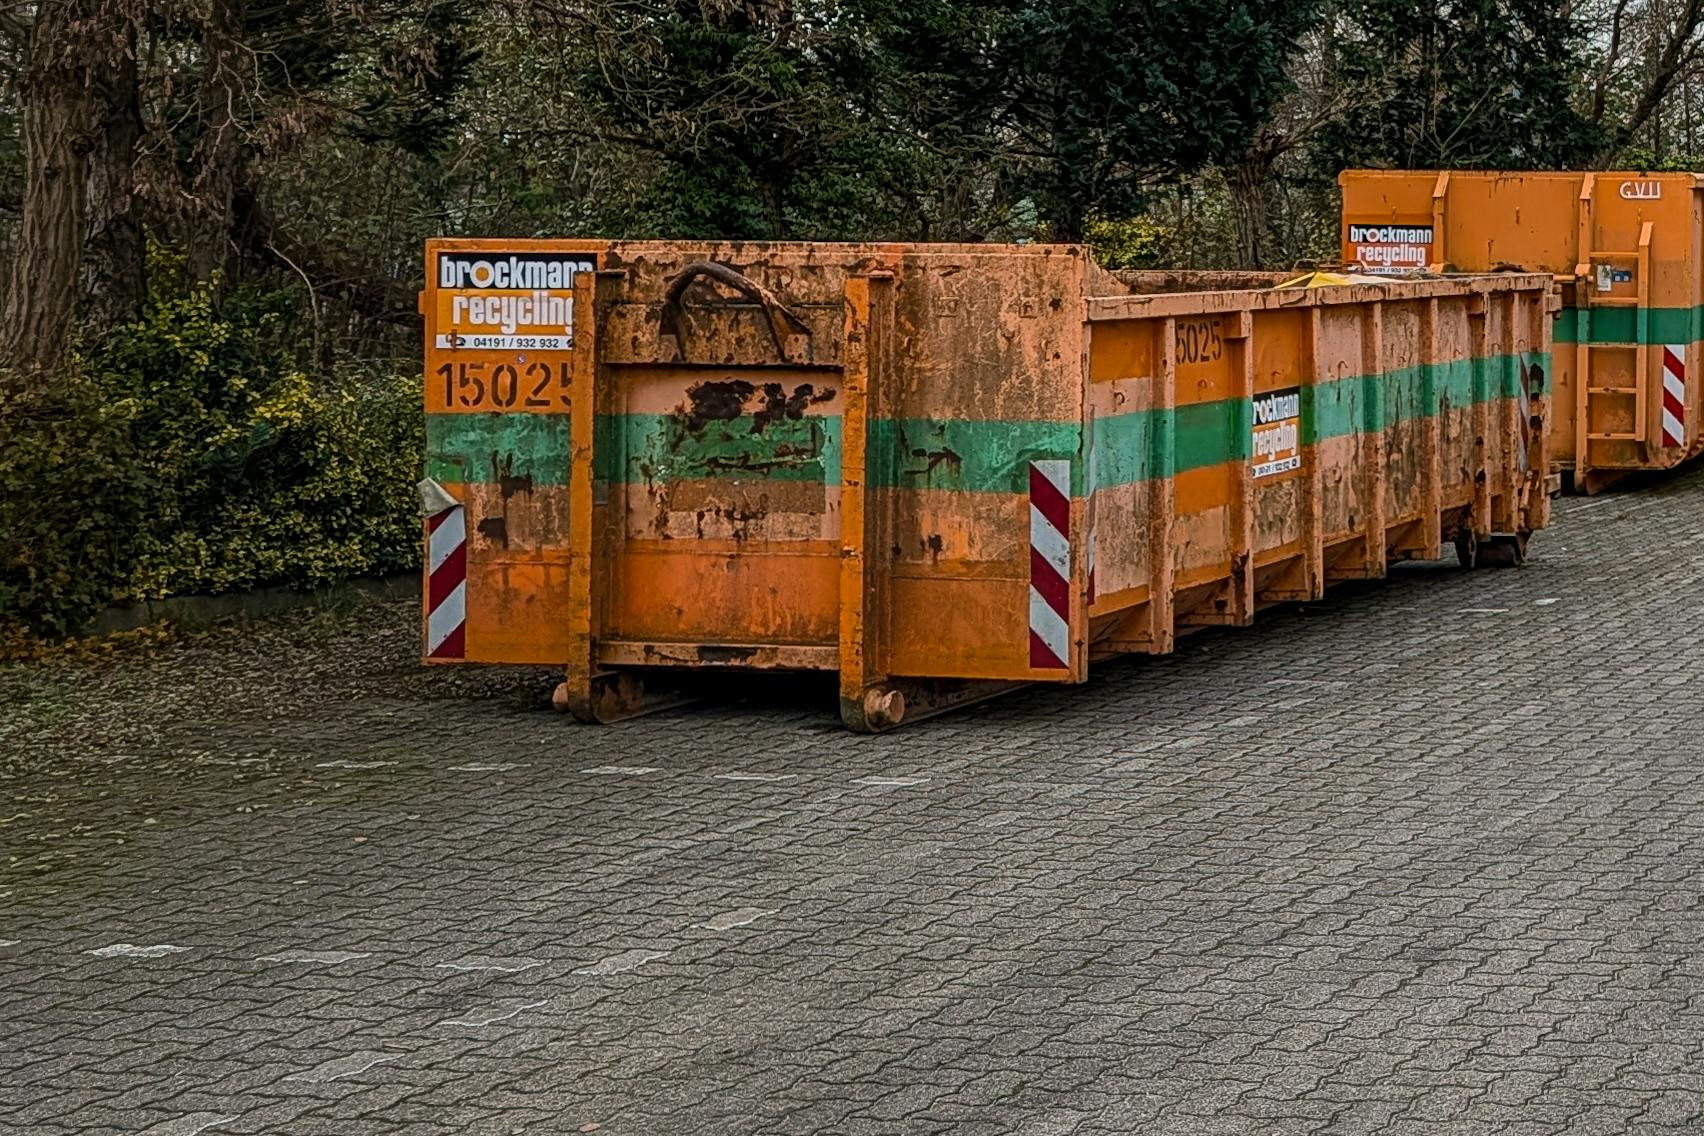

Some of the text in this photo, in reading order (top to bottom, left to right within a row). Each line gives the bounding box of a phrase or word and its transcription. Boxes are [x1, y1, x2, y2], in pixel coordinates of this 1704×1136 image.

[1350, 226, 1433, 244] brockmann
[1356, 244, 1427, 267] recycling
[473, 337, 560, 348] 04191 / 932 932
[1175, 320, 1222, 364] 5025
[1252, 393, 1300, 426] rockmann
